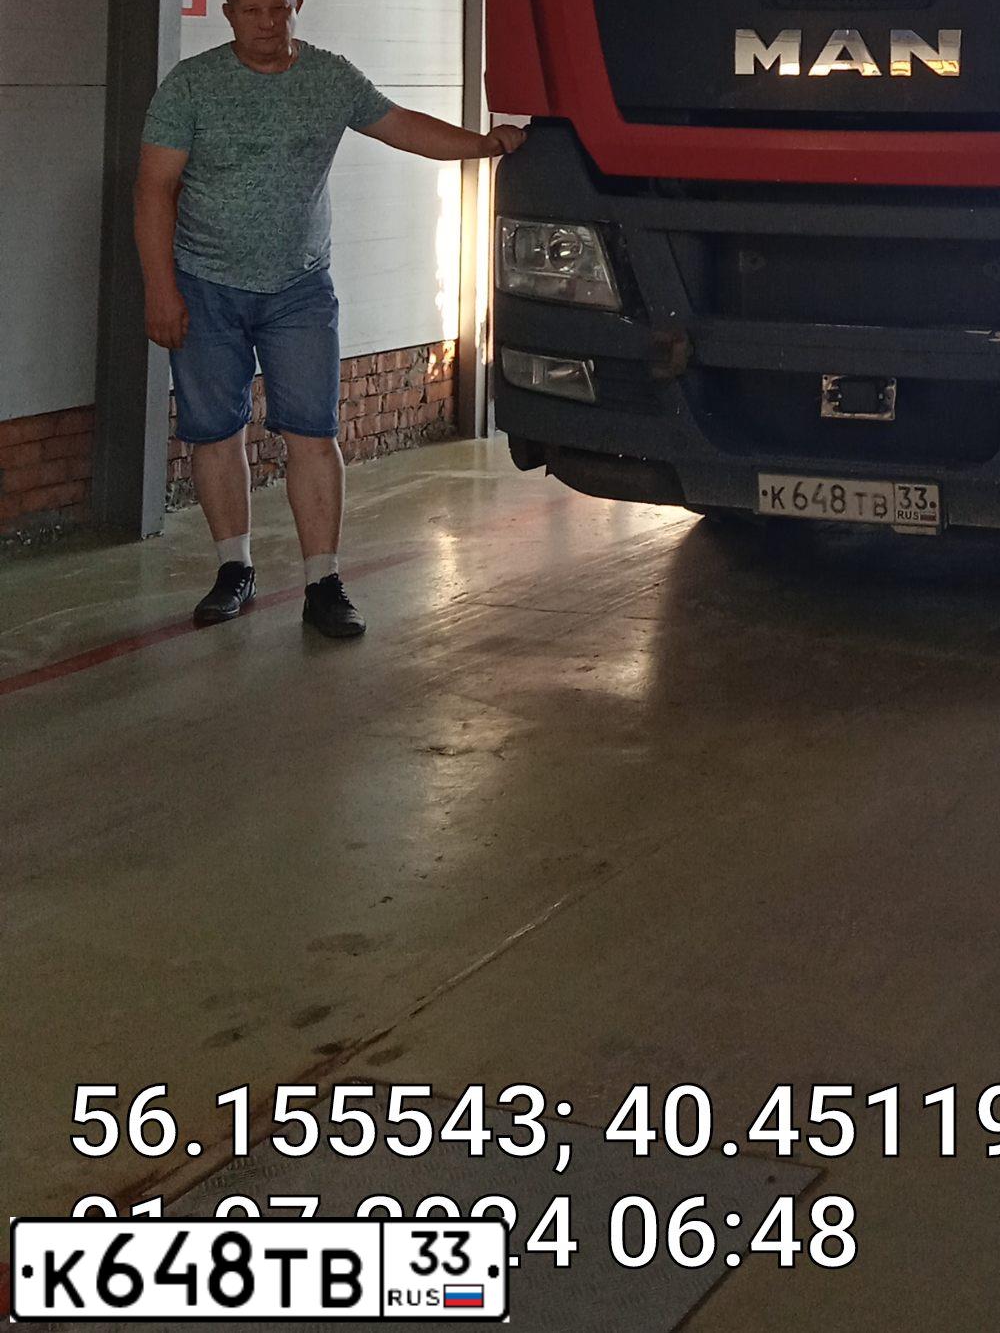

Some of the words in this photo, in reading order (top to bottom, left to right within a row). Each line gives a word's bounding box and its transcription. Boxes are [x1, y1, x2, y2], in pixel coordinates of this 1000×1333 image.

[735, 29, 961, 76] MAN
[898, 486, 928, 510] 33
[897, 510, 919, 521] RUS
